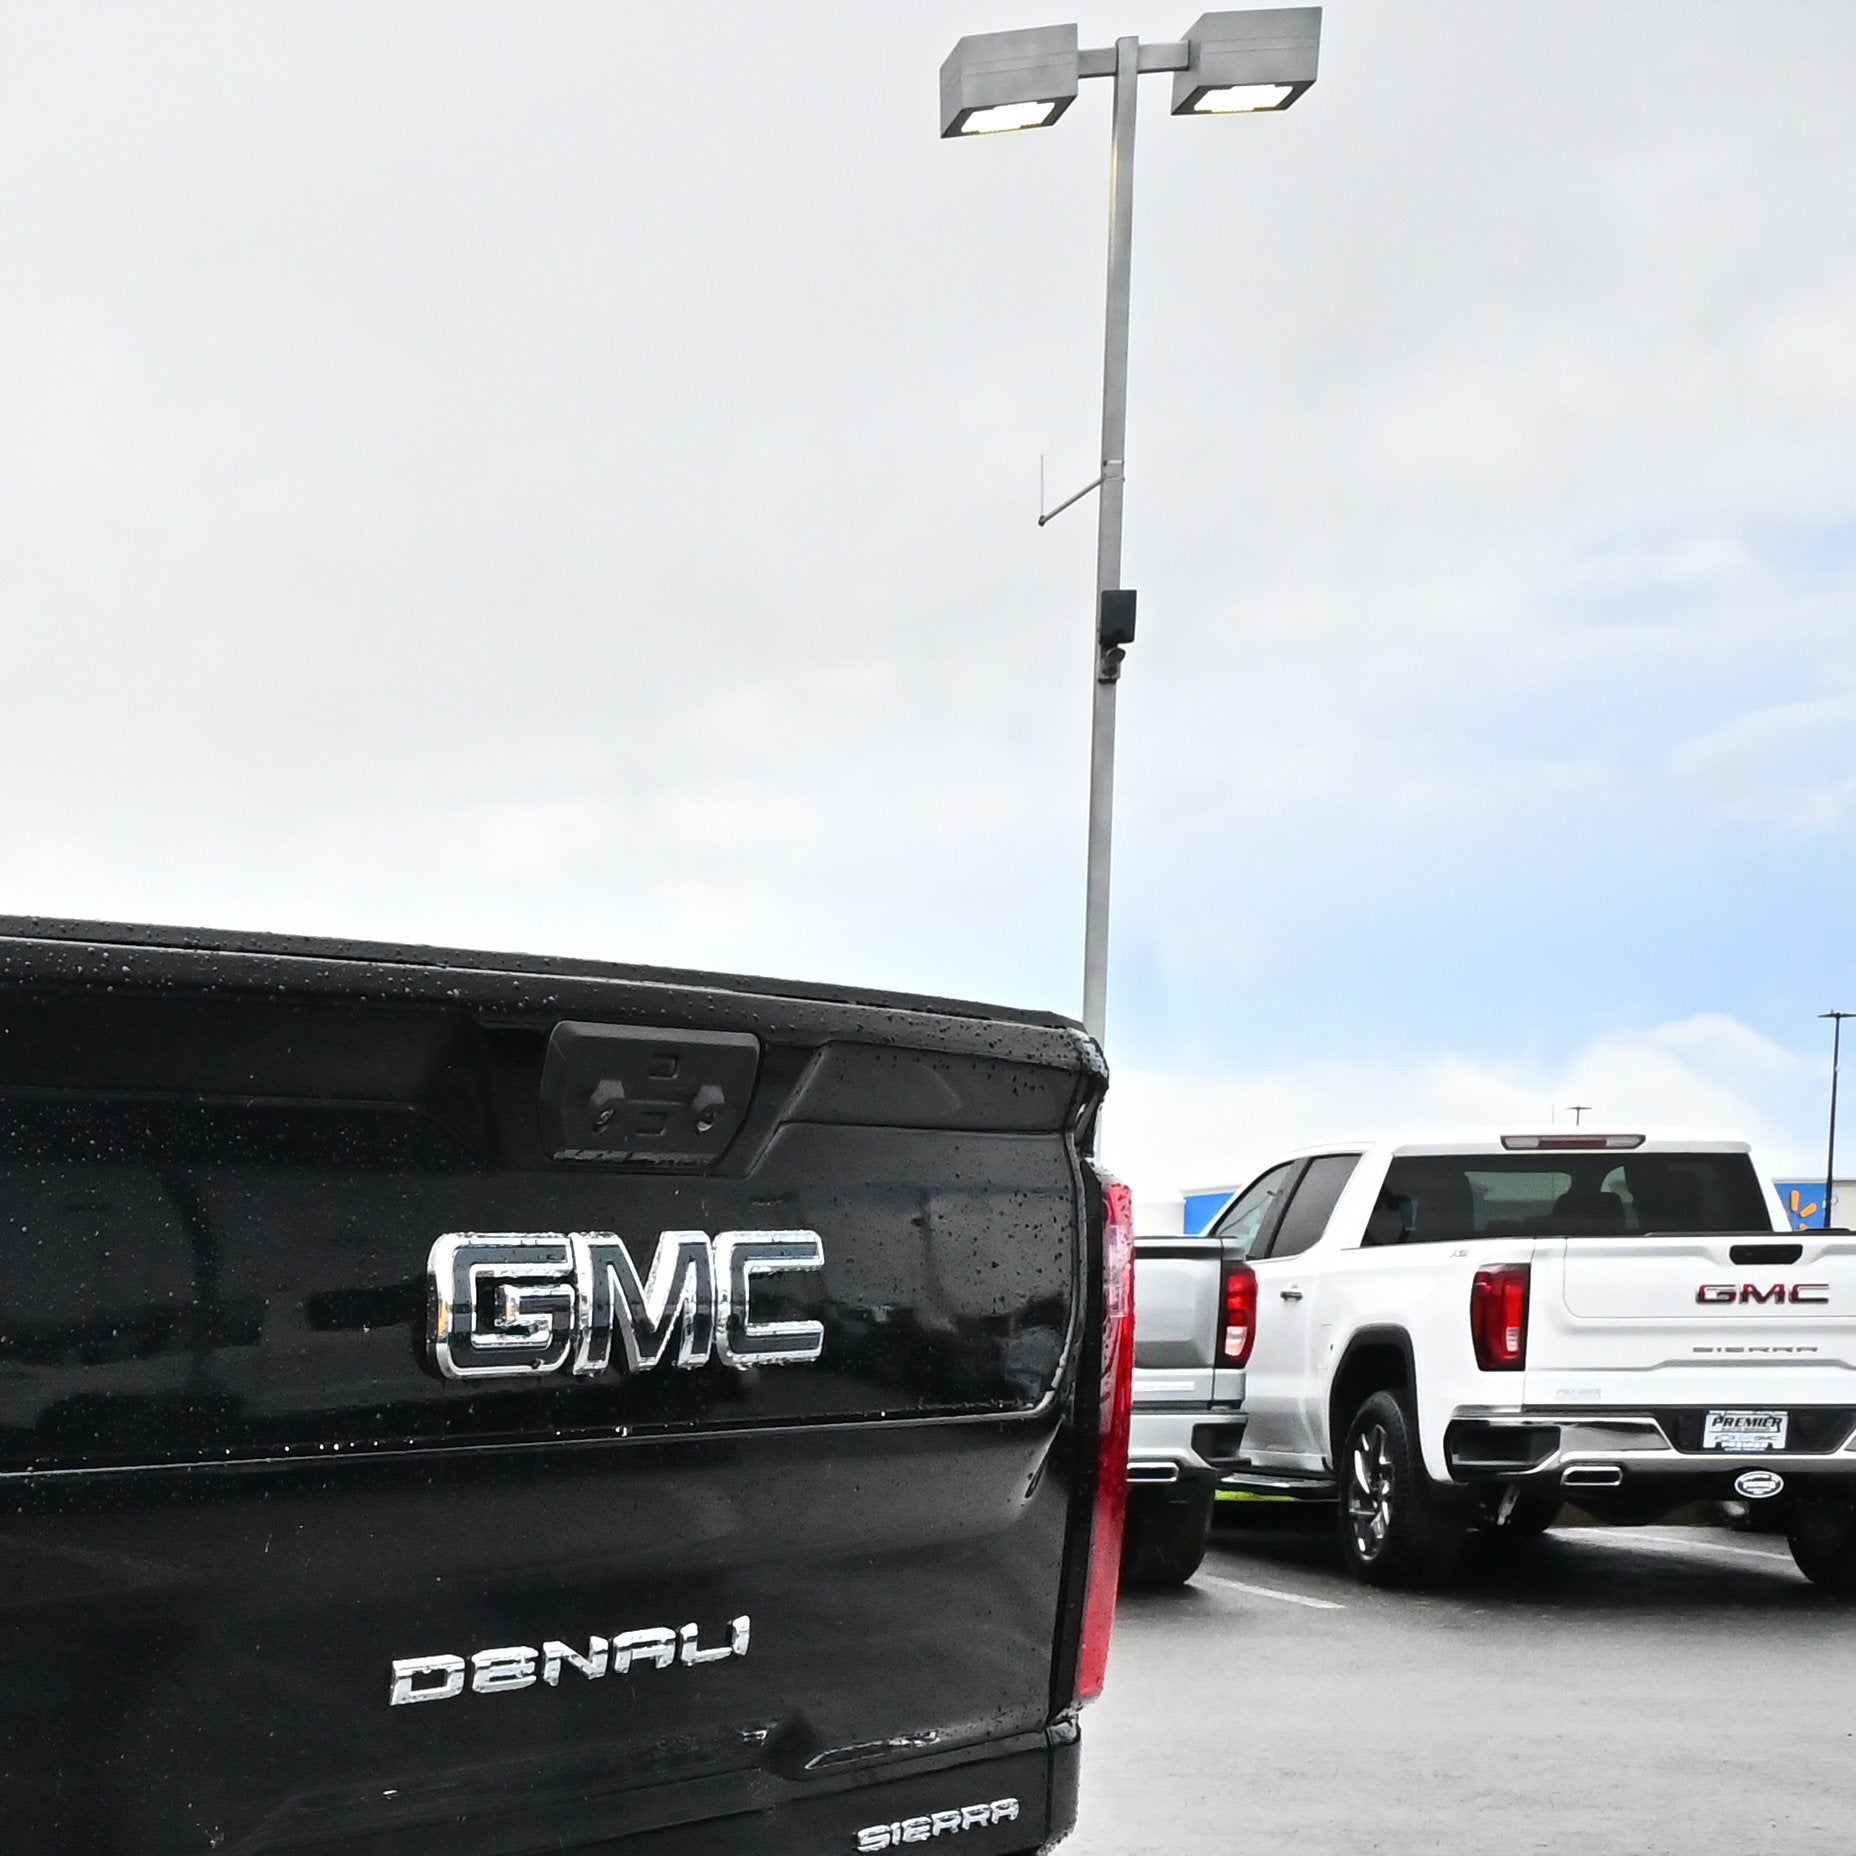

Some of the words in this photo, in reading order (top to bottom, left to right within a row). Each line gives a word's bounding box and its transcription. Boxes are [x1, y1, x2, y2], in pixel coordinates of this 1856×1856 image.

[427, 1230, 825, 1379] GMC
[1696, 1283, 1829, 1305] GMC
[1712, 1416, 1782, 1431] PREMIER
[390, 1615, 751, 1706] DENALI
[855, 1797, 1021, 1853] SIERRA
